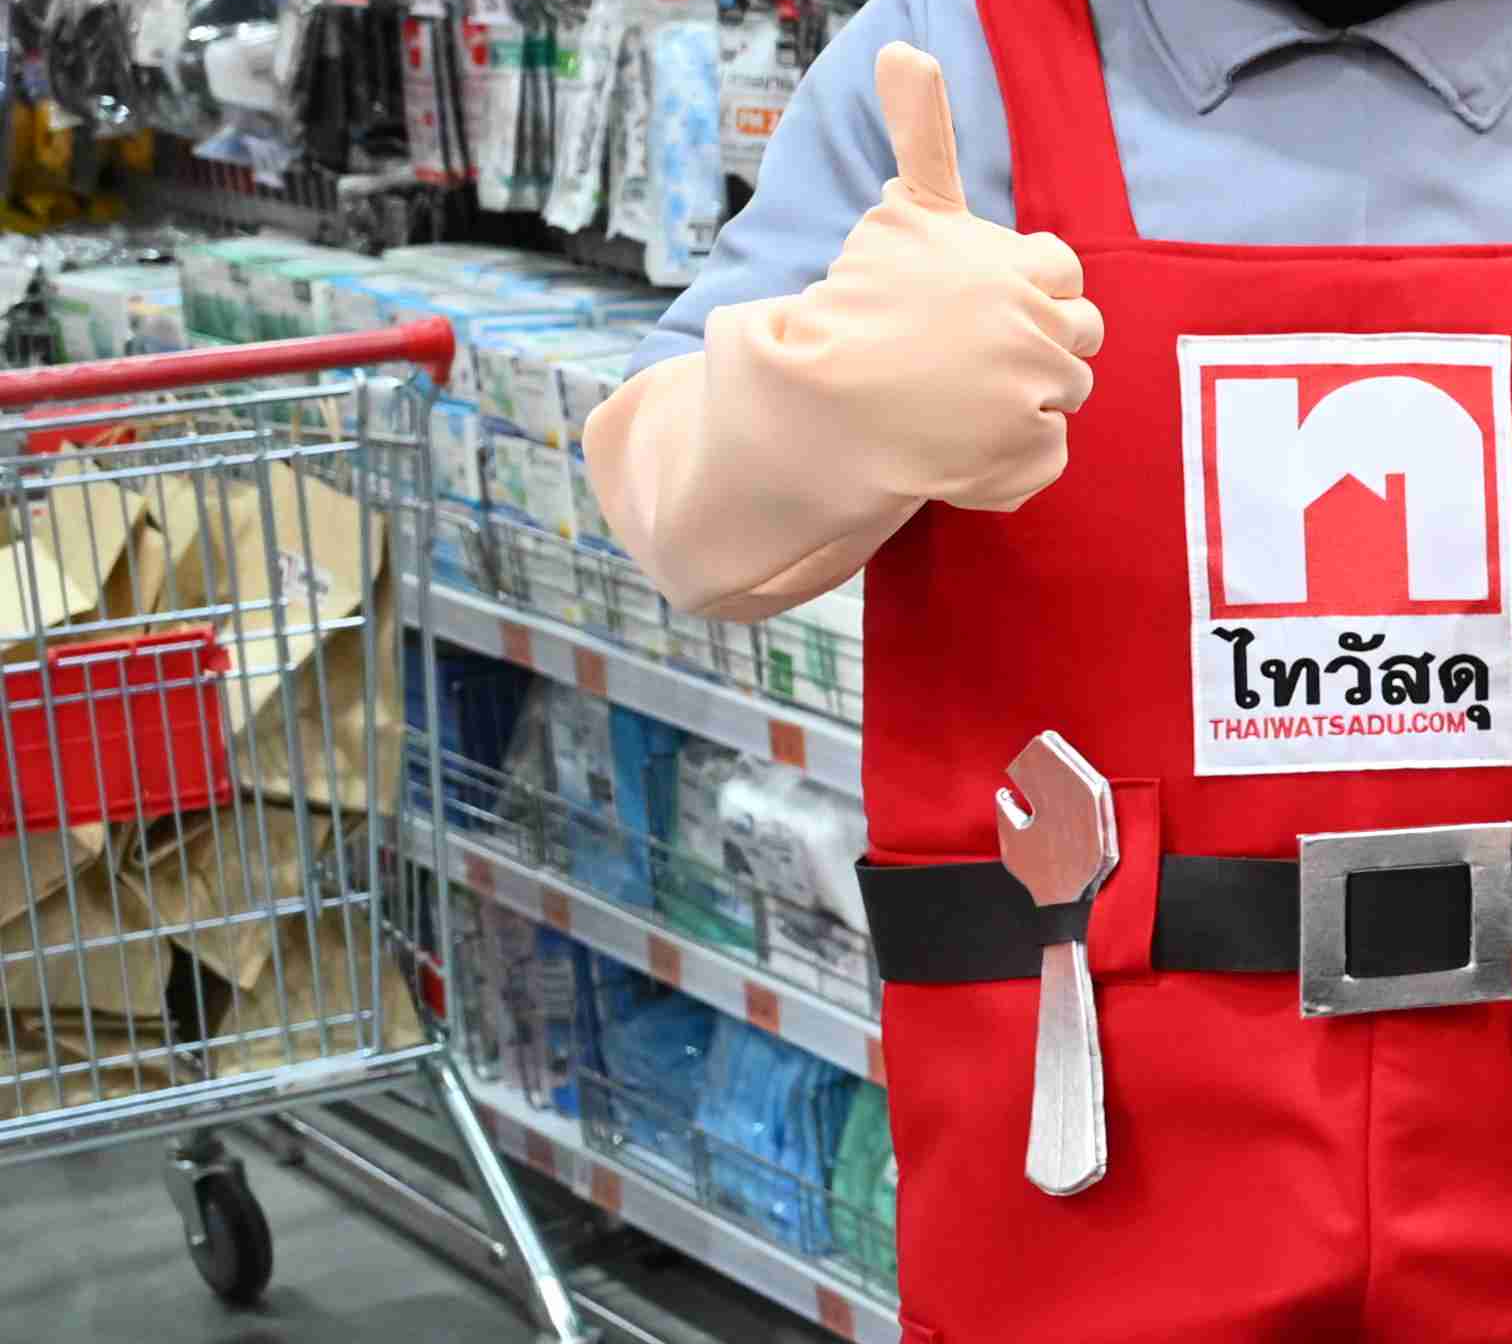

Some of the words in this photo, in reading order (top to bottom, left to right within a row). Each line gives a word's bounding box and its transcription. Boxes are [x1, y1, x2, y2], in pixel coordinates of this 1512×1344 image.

[1212, 627, 1493, 731] ไทวัสดุ
[1209, 711, 1468, 742] THAIWATSADU.COM
